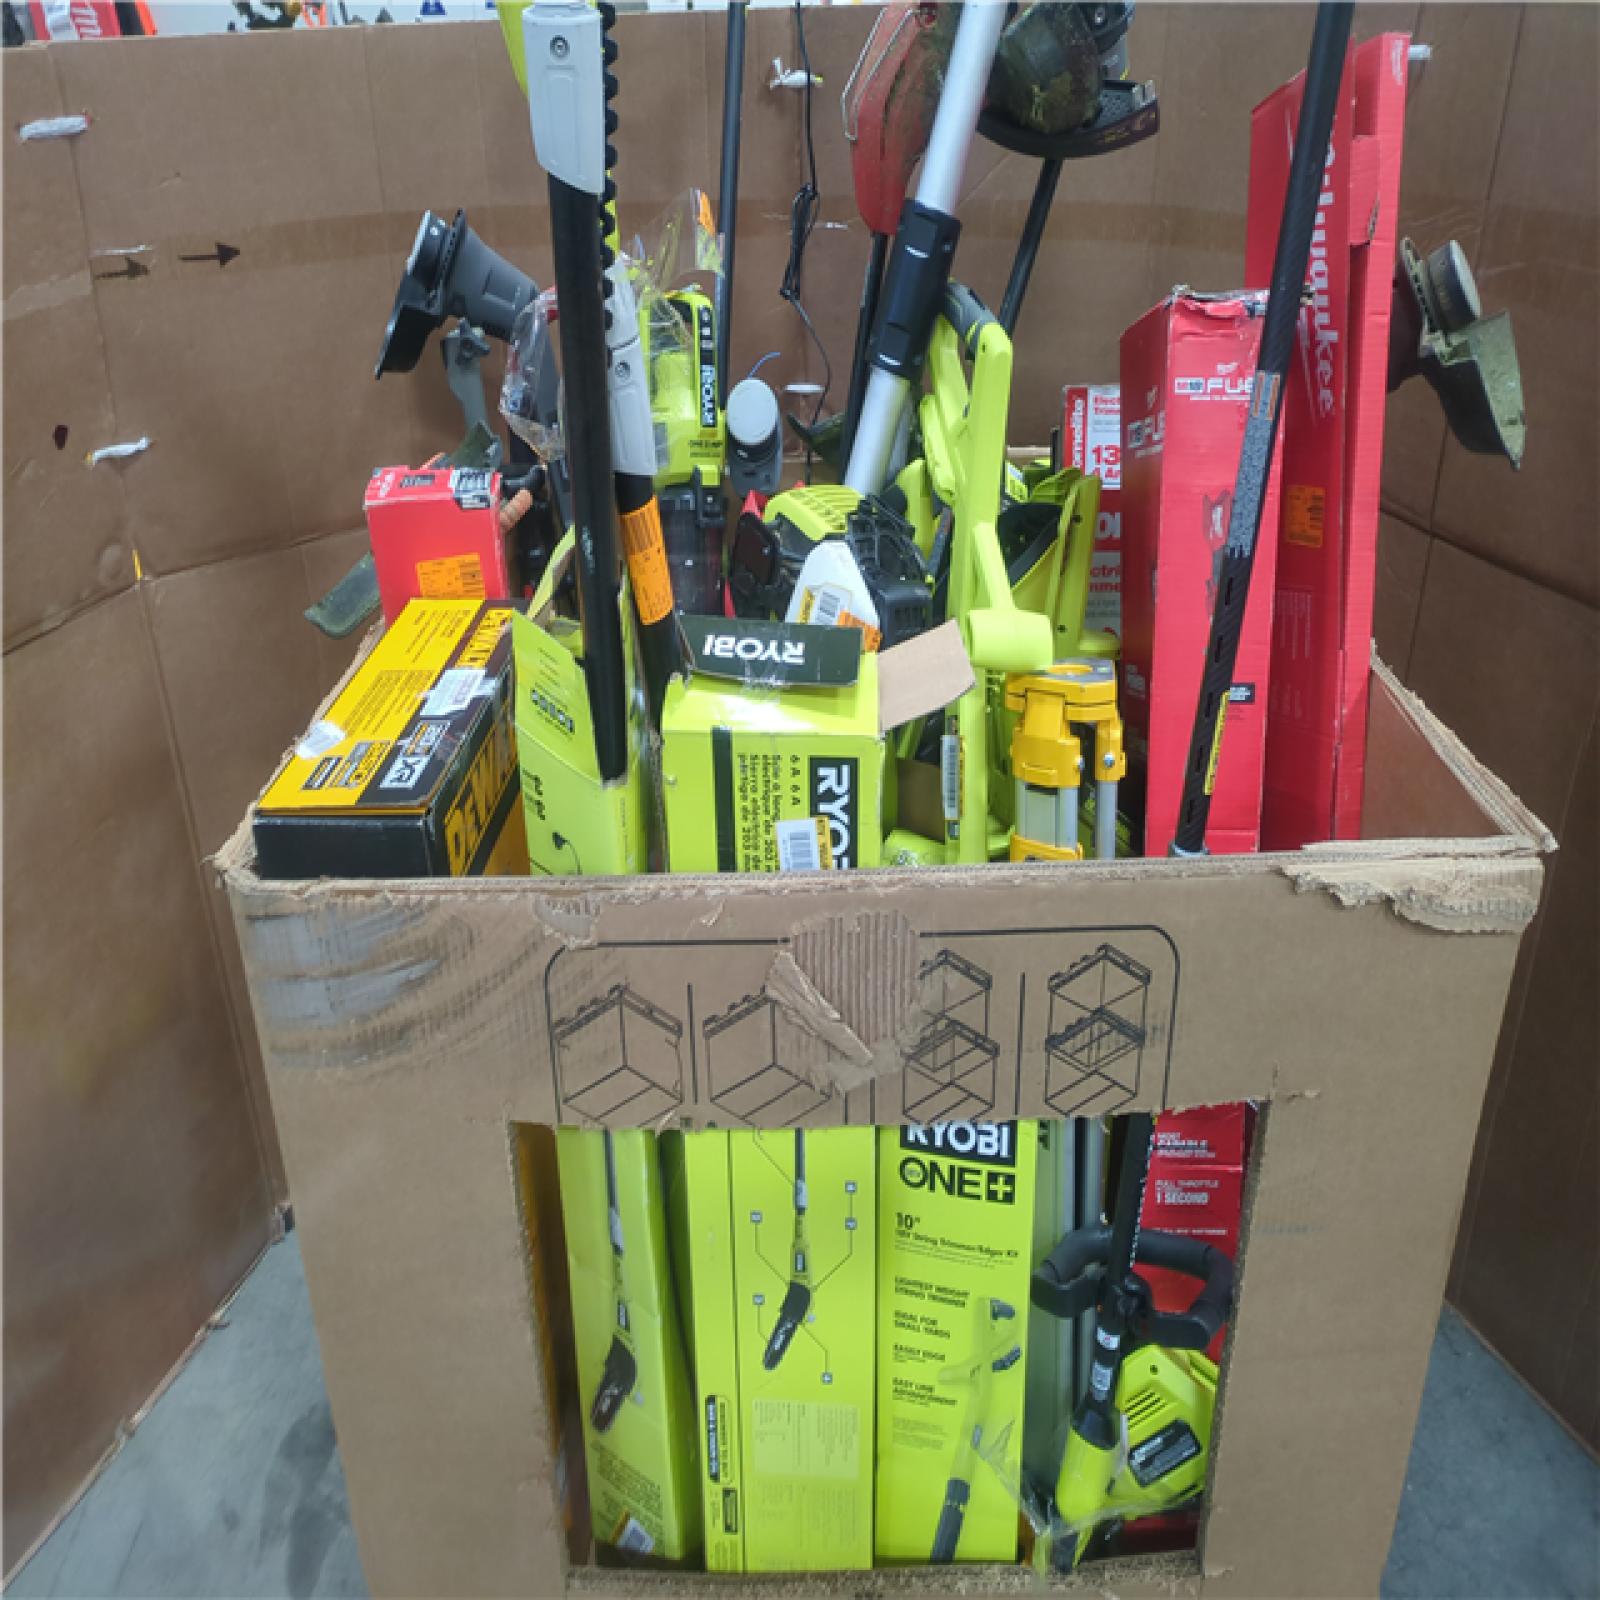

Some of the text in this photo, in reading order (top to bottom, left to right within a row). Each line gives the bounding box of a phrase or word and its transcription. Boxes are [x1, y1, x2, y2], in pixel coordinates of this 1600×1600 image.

[1206, 376, 1254, 394] FUE
[702, 633, 806, 665] RYOBI
[815, 763, 851, 870] RYO
[906, 1121, 1011, 1158] RYOBI
